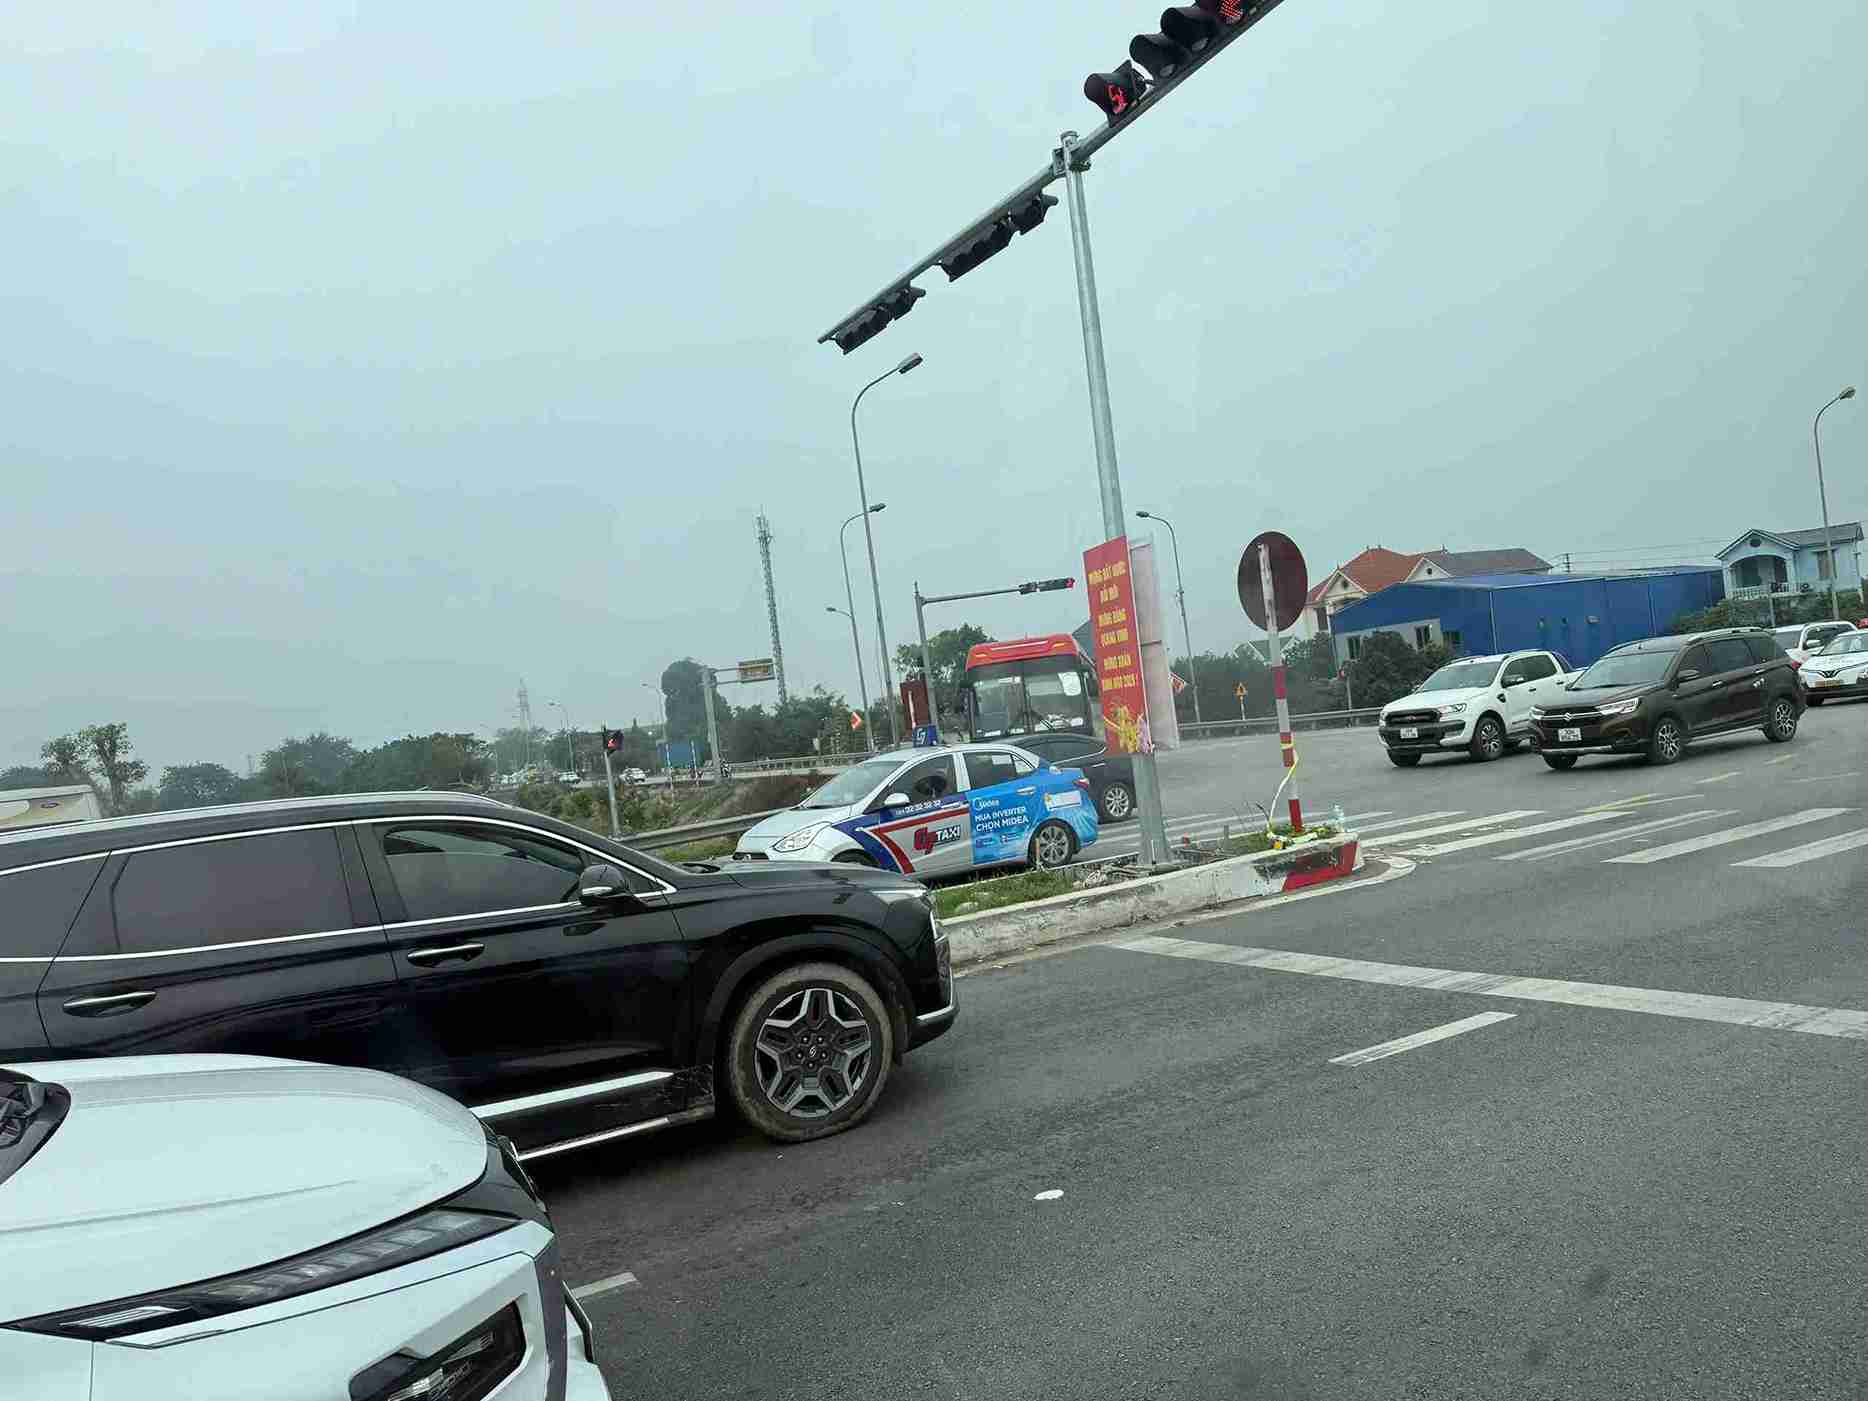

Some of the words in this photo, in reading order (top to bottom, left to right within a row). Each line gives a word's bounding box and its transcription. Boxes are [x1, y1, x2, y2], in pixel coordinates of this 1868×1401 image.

[975, 813, 991, 823] MUA
[992, 806, 1026, 820] INVERTER
[1002, 815, 1029, 827] MIDEA
[936, 825, 960, 841] TAXI
